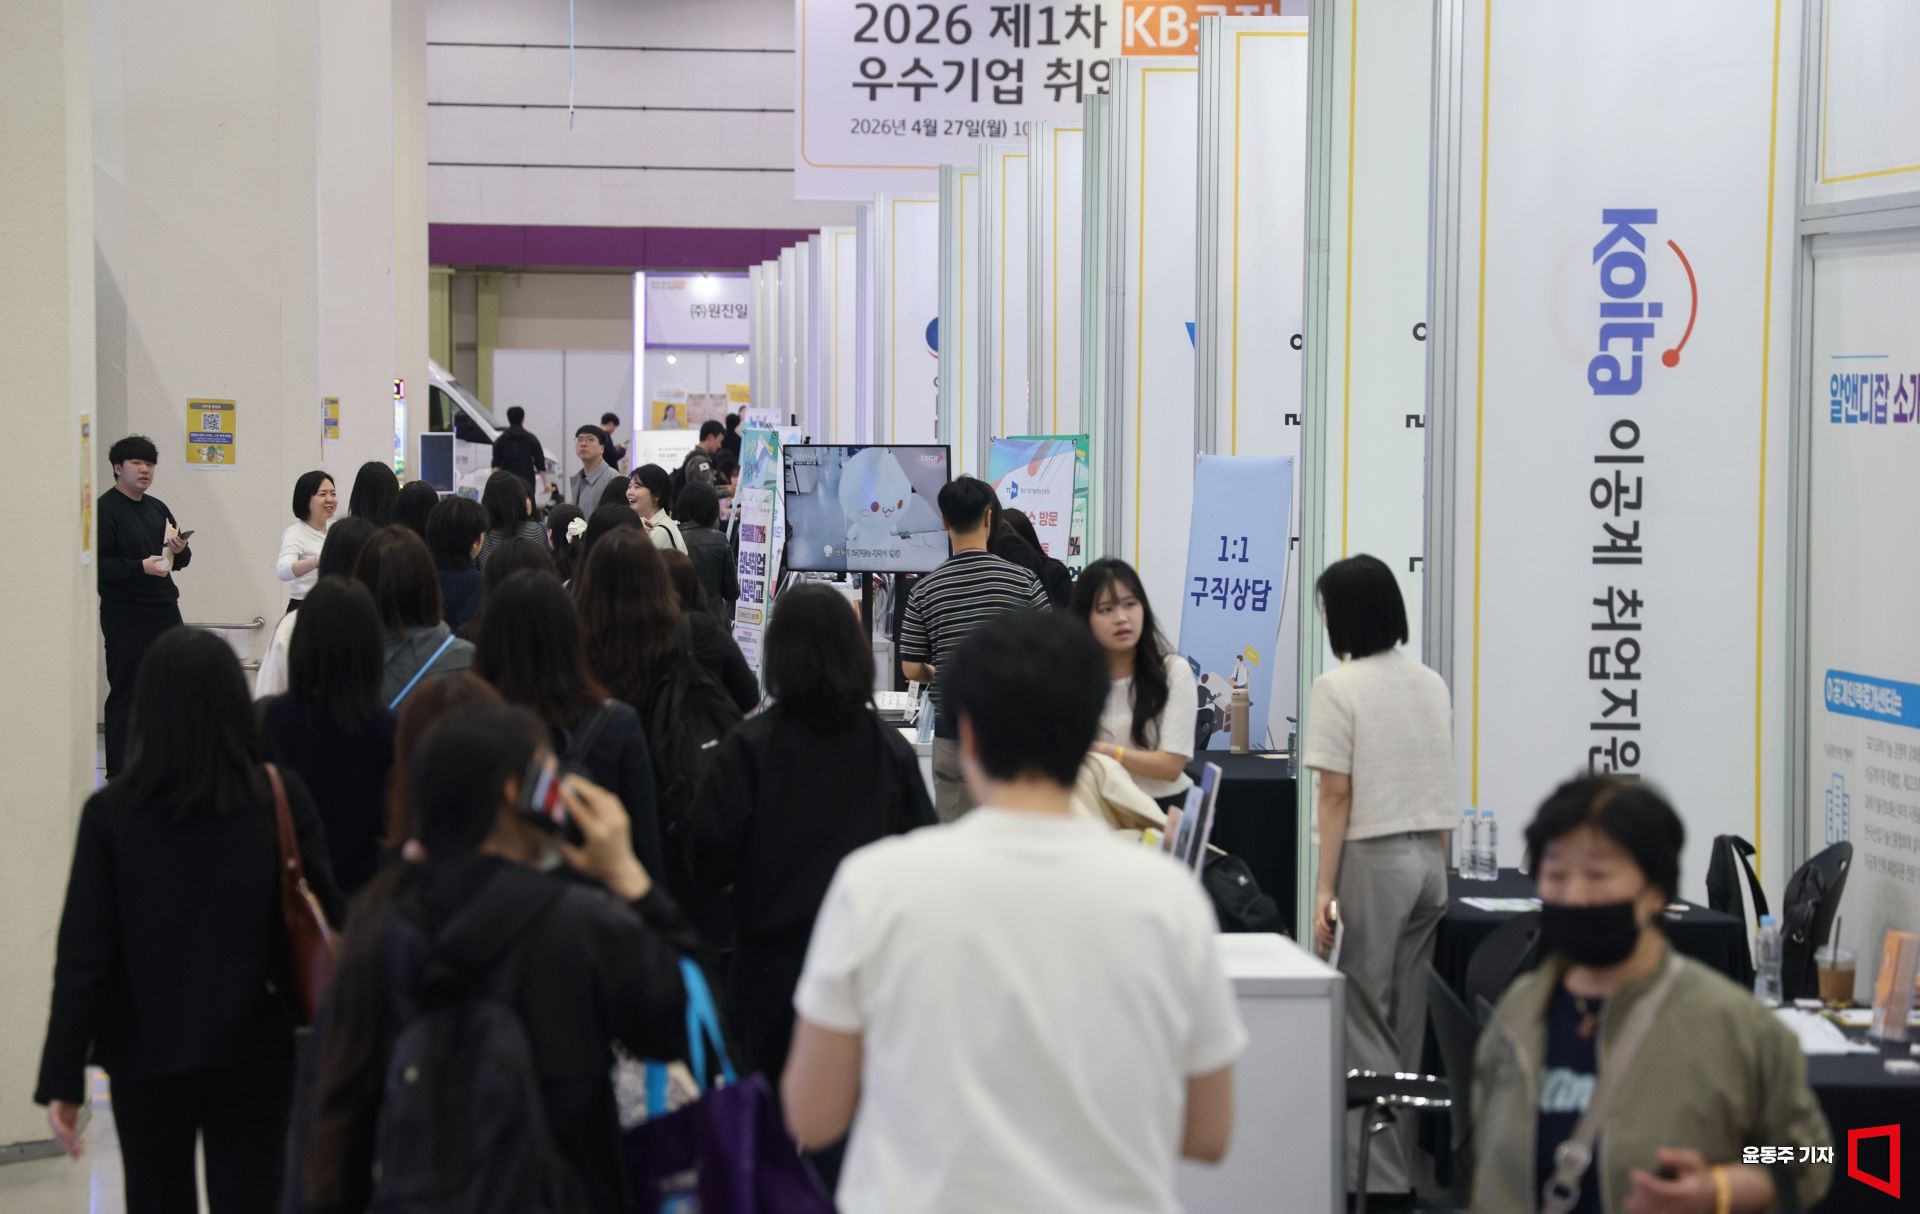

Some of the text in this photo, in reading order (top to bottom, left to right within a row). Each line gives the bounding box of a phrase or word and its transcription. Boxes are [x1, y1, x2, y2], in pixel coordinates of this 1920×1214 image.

[853, 3, 972, 44] 2026
[988, 3, 1107, 48] 제1차
[852, 58, 1024, 104] 우수기업
[850, 119, 907, 136] 2026년
[911, 118, 938, 137] 4월
[943, 118, 1007, 138] 27일(월)
[1830, 373, 1890, 425] 알앤디잡
[1590, 419, 1645, 564] 이공계
[1039, 511, 1059, 527] 방문
[1218, 535, 1250, 563] 1:1
[1190, 576, 1272, 612] 구직상담
